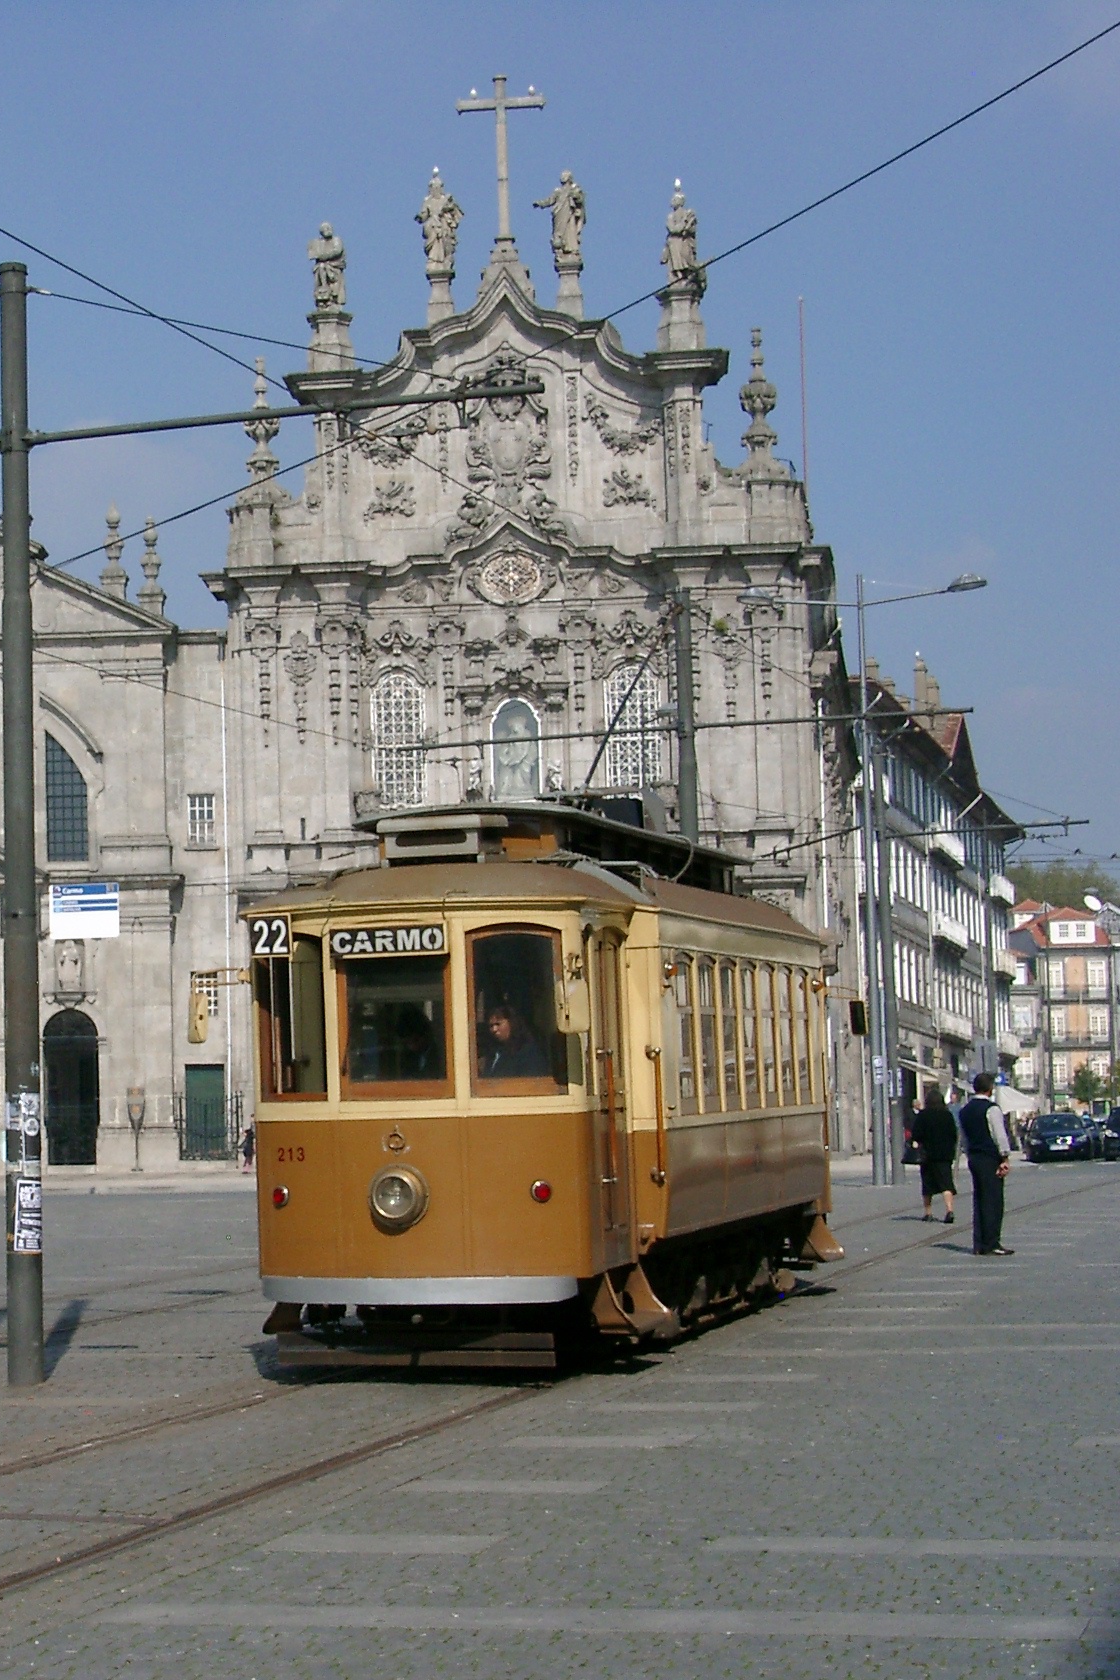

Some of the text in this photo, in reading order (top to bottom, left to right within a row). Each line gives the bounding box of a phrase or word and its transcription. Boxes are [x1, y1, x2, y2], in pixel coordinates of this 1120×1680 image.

[253, 919, 288, 954] 22
[332, 928, 443, 954] CARMO
[277, 1147, 305, 1162] 213
